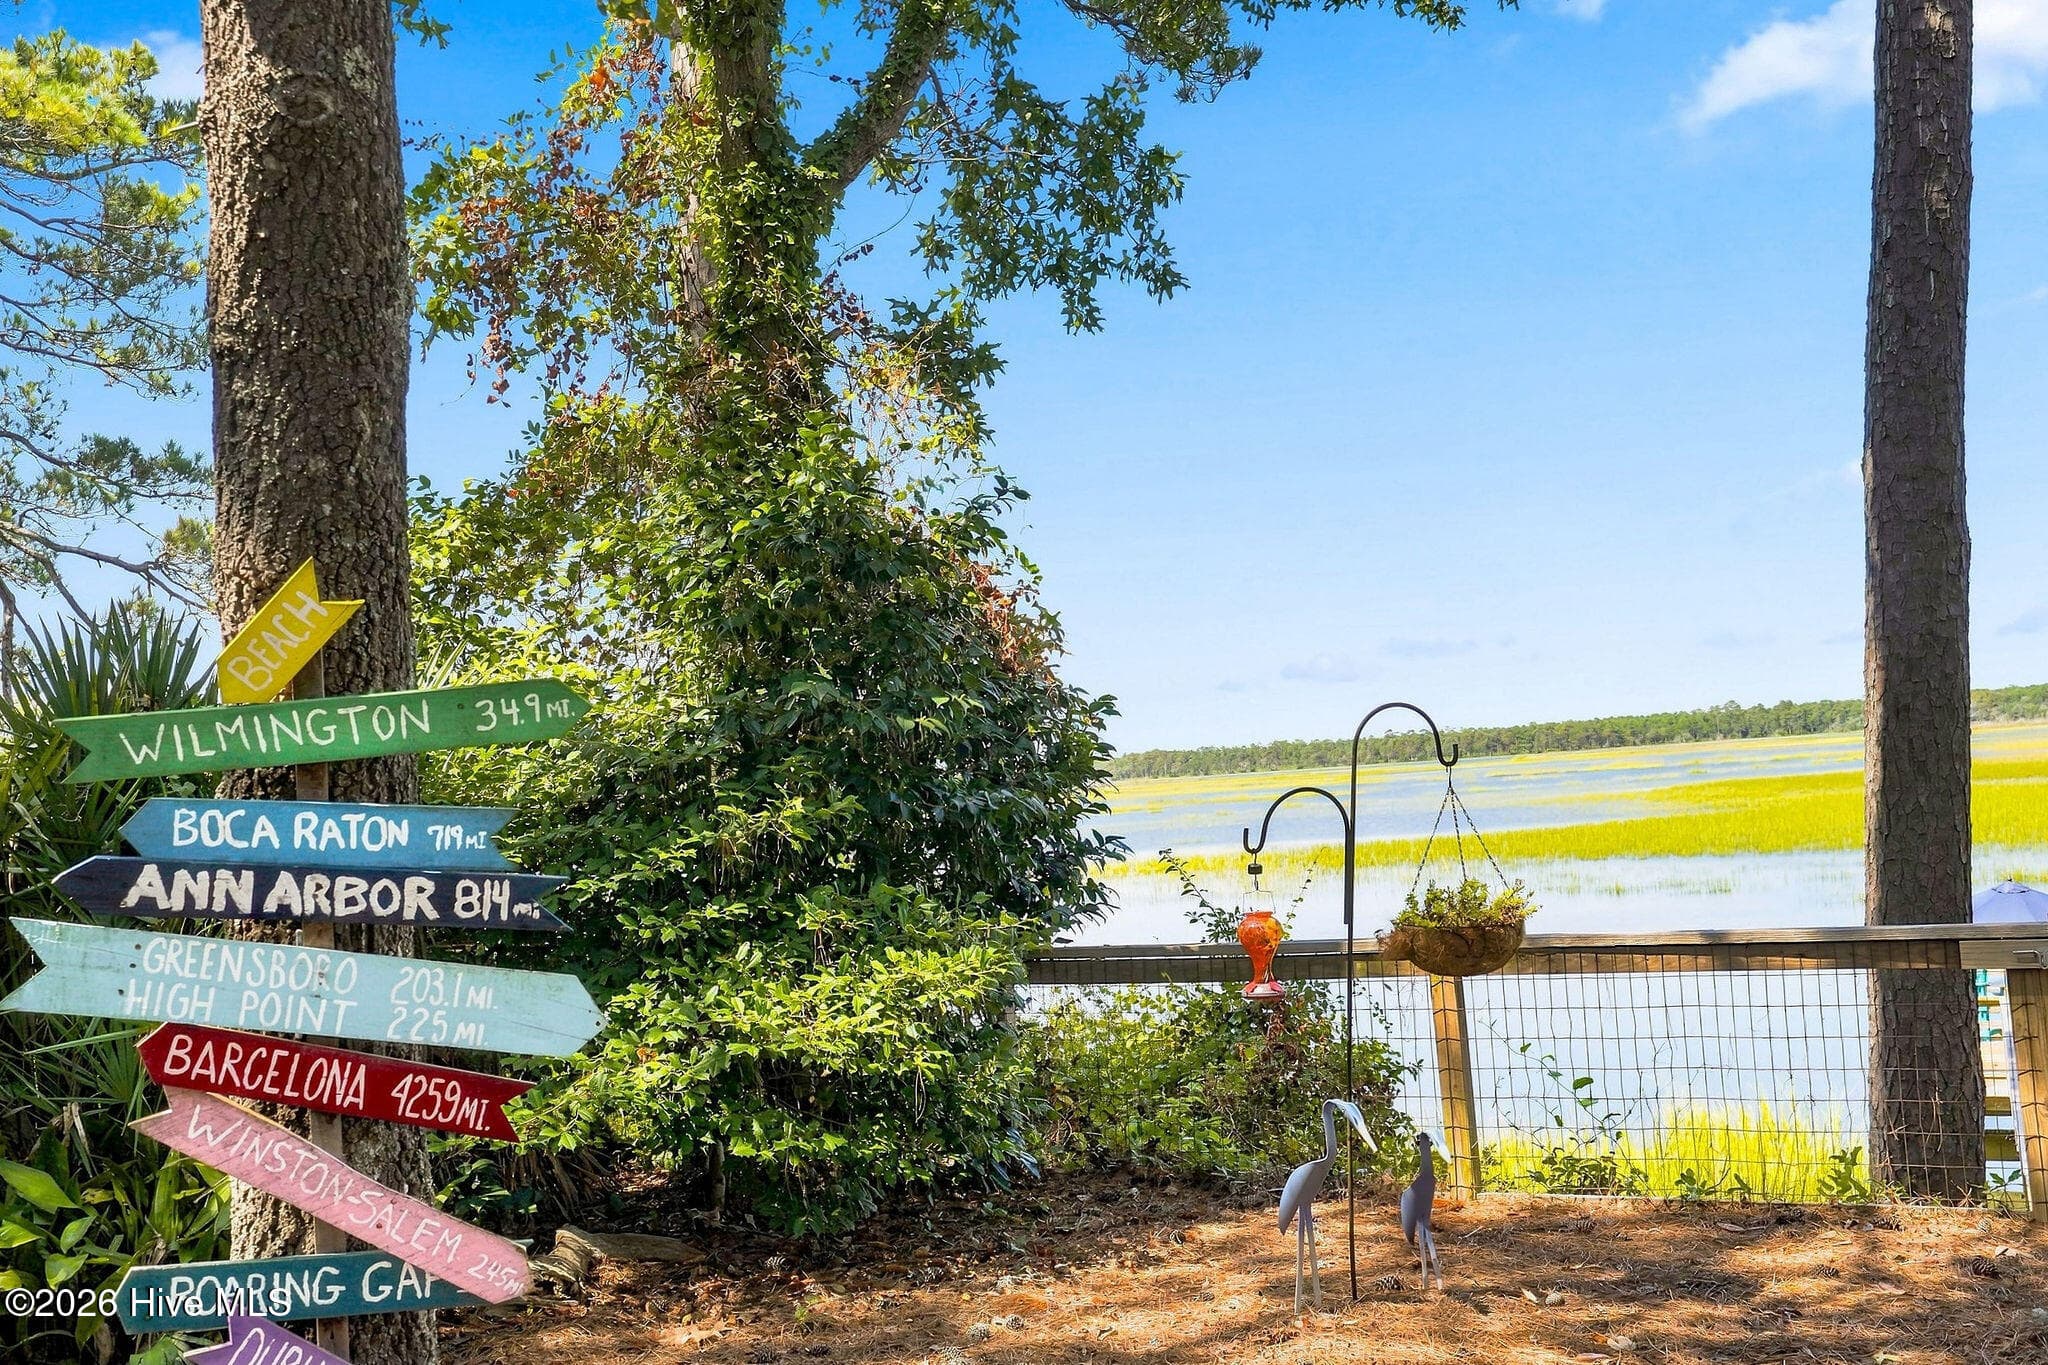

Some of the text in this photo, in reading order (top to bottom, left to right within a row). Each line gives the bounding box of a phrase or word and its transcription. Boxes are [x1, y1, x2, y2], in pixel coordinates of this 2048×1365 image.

[226, 591, 330, 693] BEACH
[119, 700, 431, 766] WILMINGTON
[475, 693, 541, 732] 34.9
[172, 807, 281, 849] BOCA
[293, 810, 409, 852] RATON
[120, 863, 254, 916] ANN
[264, 871, 441, 921] ARBOR
[453, 878, 511, 922] 814
[141, 936, 359, 994] GREENSBORO
[389, 965, 465, 1009] 203.1
[124, 977, 213, 1024] HIGH
[237, 990, 358, 1035] POINT
[386, 1005, 448, 1043] 225
[163, 1034, 367, 1111] BARCELONA
[187, 1103, 463, 1264] WINSTON-SALEM
[170, 1265, 347, 1317] ROARING
